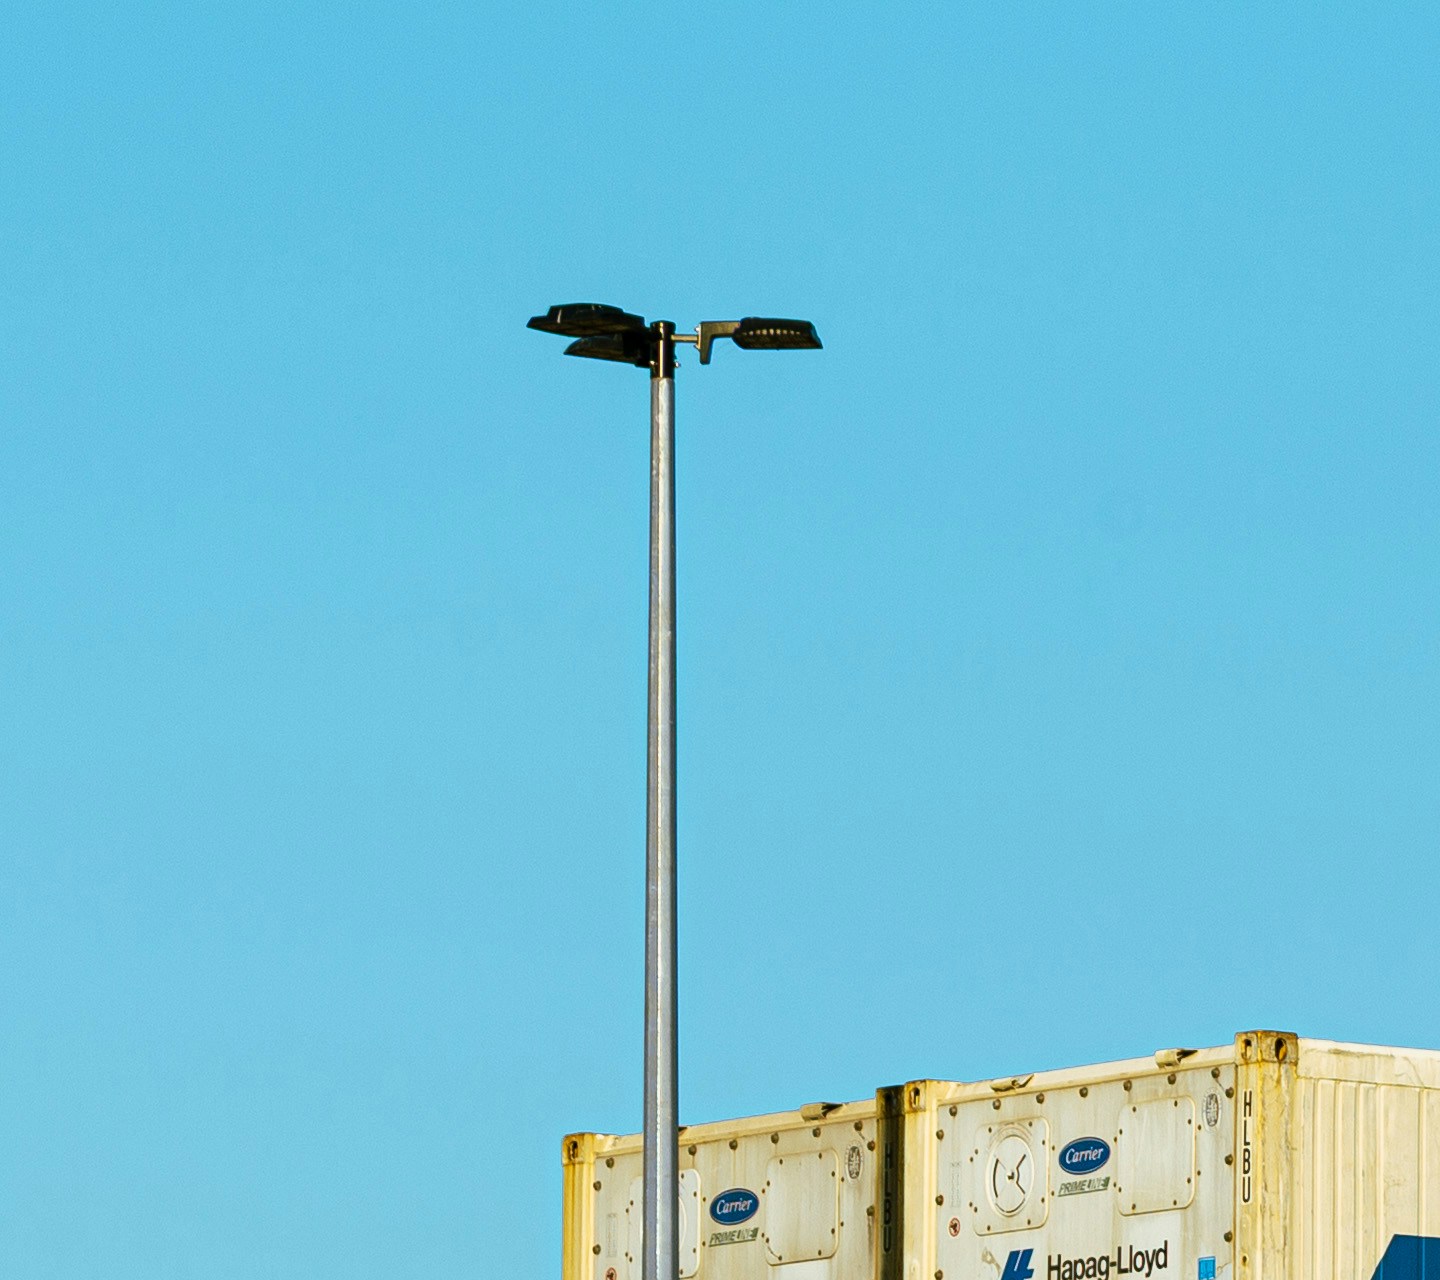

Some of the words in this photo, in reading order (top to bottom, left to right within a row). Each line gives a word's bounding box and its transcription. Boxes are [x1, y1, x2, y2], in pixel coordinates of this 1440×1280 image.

[1065, 1146, 1104, 1165] Carrier
[1242, 1090, 1252, 1204] HLBU
[716, 1197, 753, 1215] Carrier
